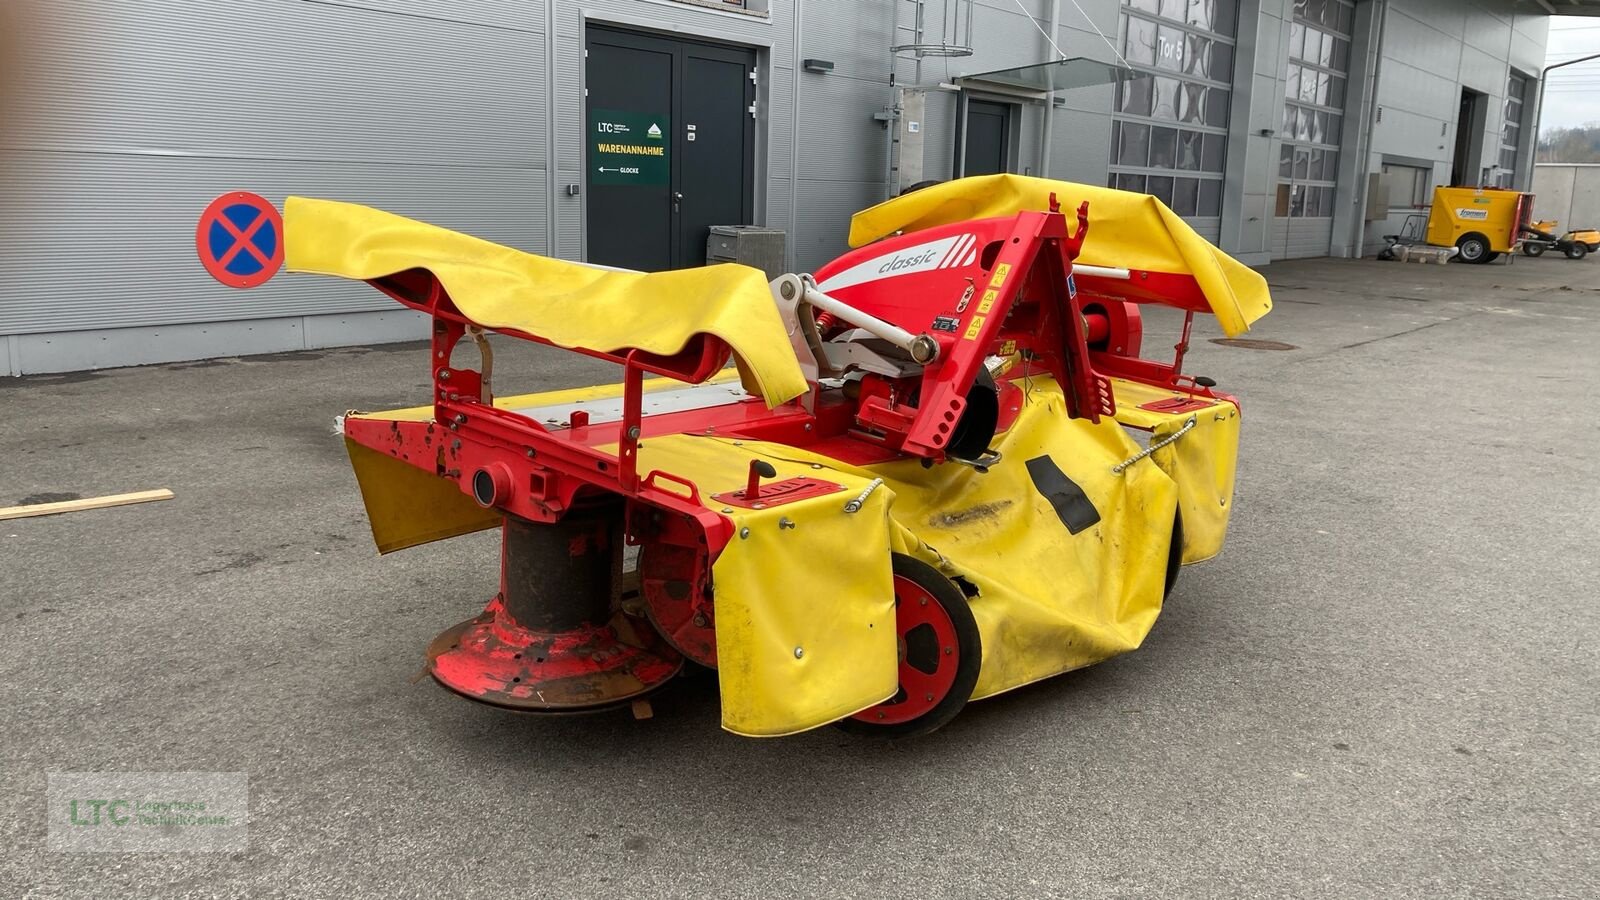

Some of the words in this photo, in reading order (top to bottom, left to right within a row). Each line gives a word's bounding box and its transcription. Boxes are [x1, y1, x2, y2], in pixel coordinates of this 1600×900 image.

[1159, 36, 1175, 59] Tor
[1176, 41, 1183, 61] 5
[598, 122, 613, 132] LTC
[598, 143, 664, 156] WARENANNAHME
[878, 249, 937, 274] classic
